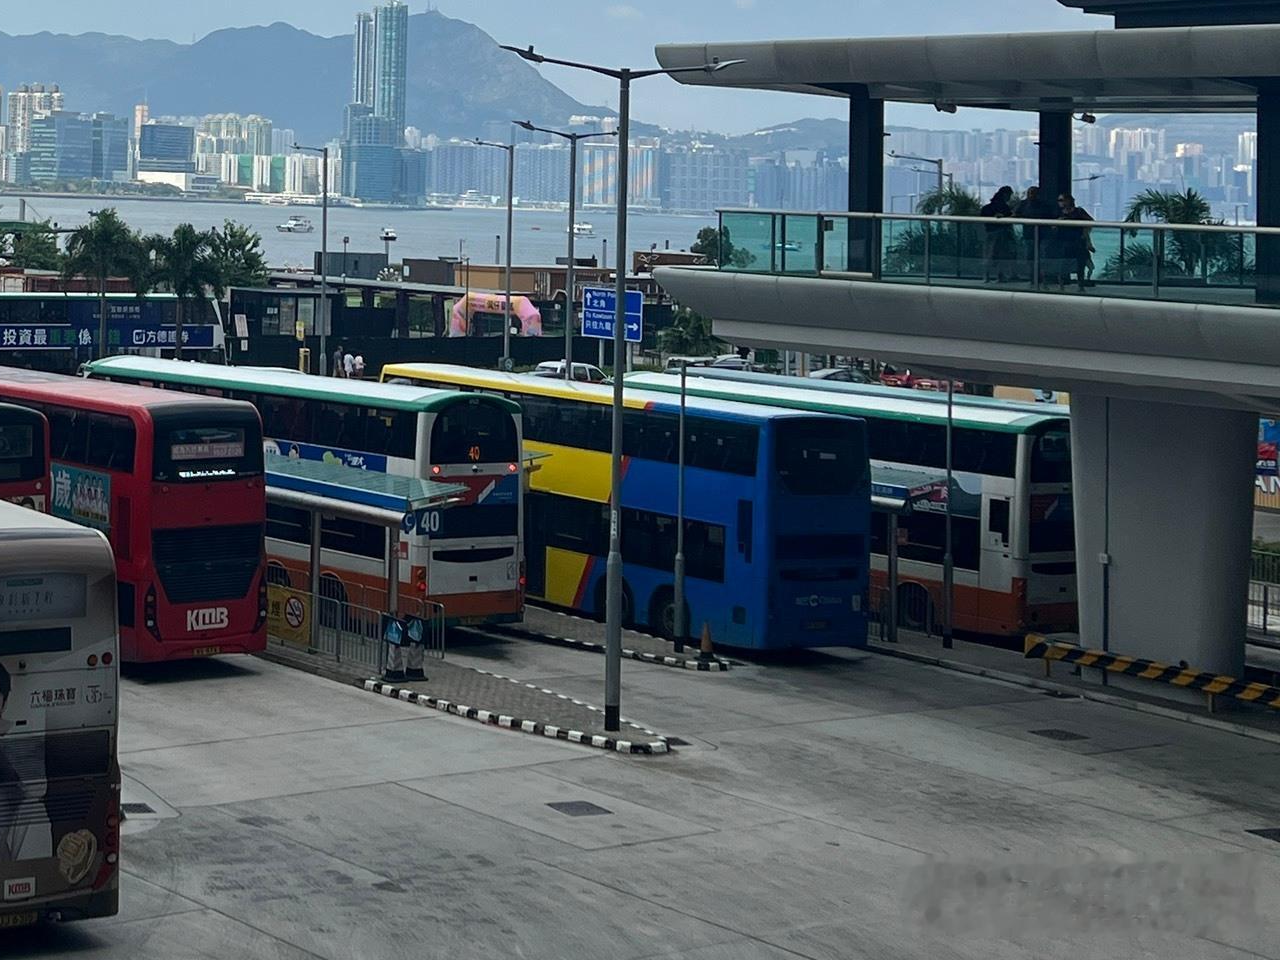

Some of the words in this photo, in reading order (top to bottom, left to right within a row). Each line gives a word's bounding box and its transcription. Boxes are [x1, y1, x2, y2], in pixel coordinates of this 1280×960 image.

[592, 299, 606, 308] 北角
[468, 446, 481, 461] 40
[50, 469, 72, 509] 歲
[421, 511, 440, 532] 40
[186, 607, 229, 631] KMB
[30, 687, 77, 705] 六福珠寶
